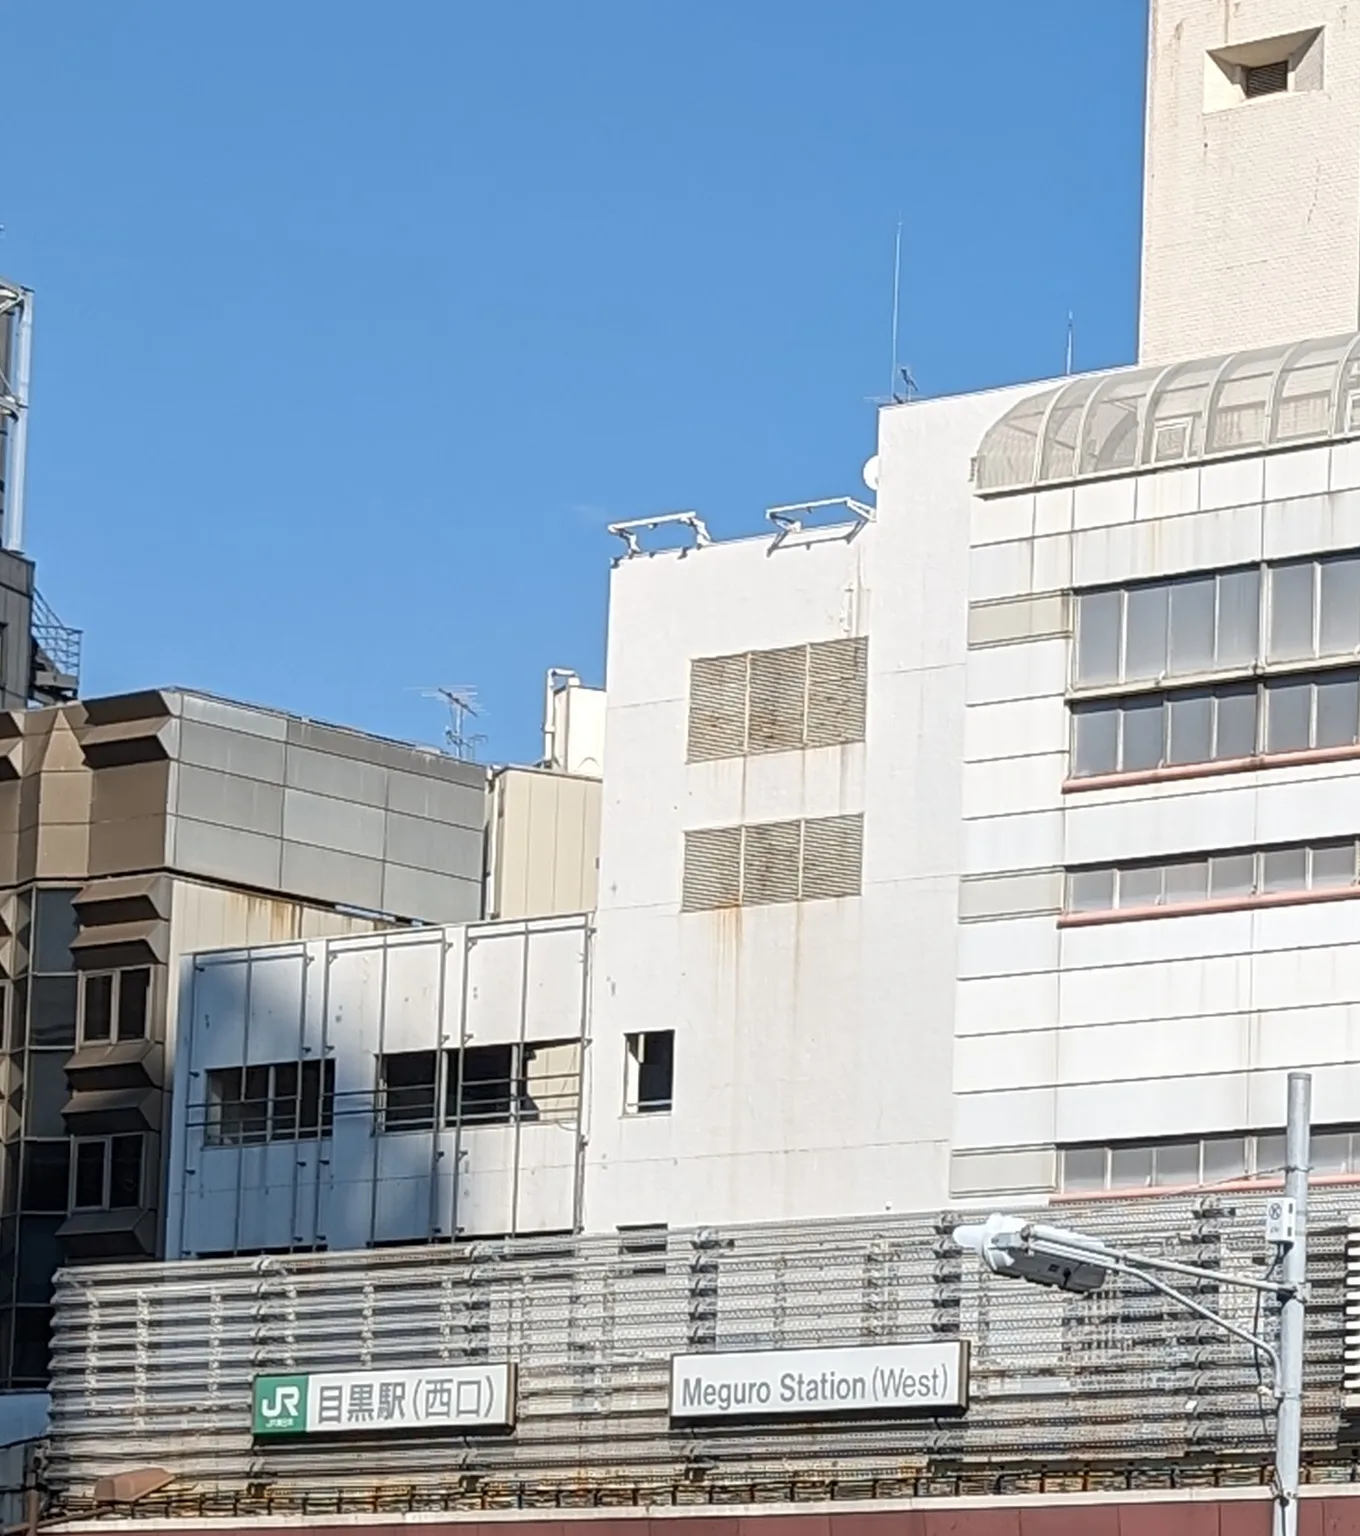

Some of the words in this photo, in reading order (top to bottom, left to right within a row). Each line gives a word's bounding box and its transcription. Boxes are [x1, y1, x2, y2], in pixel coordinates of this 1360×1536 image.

[262, 1386, 300, 1417] JR
[682, 1377, 771, 1411] Meguro
[780, 1371, 866, 1402] Station
[872, 1363, 948, 1402] (West)
